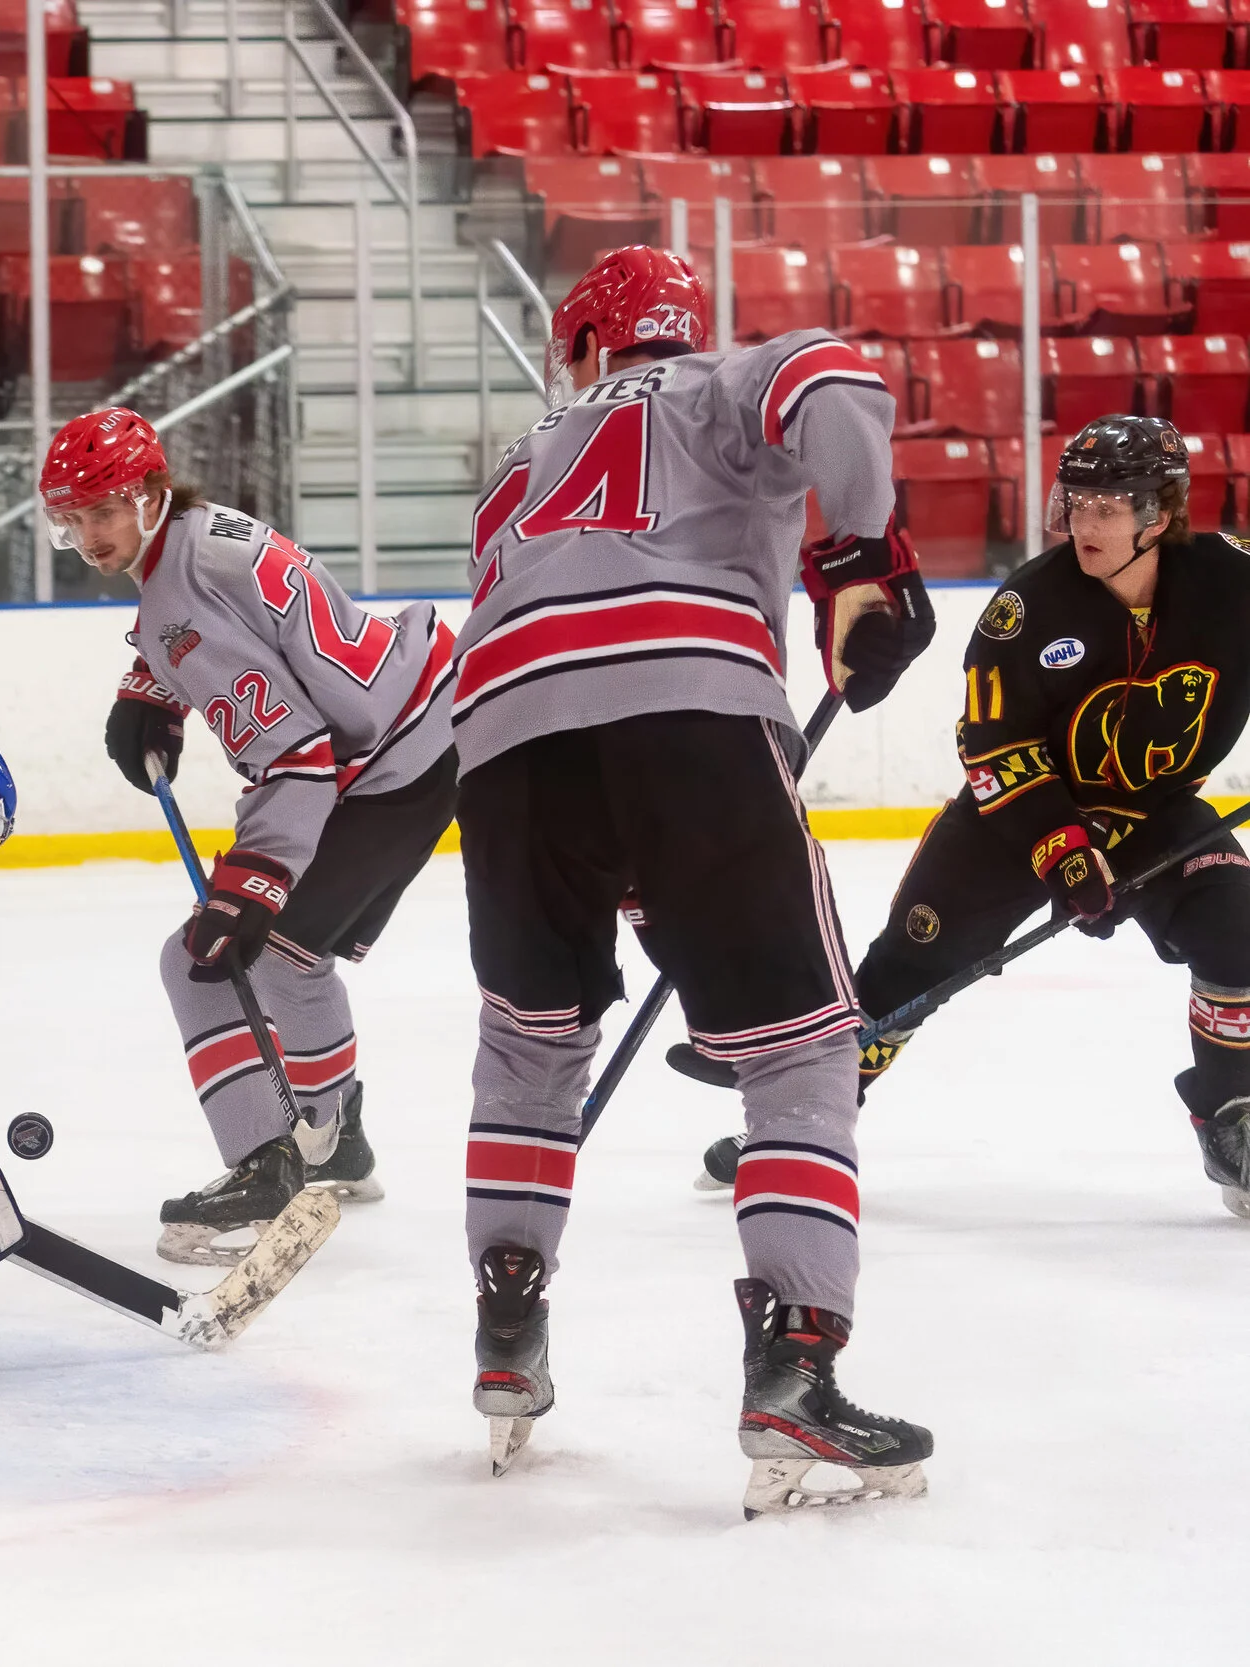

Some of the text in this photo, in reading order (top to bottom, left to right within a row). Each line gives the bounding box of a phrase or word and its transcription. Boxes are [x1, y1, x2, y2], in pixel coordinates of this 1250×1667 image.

[658, 304, 693, 341] 24
[1043, 643, 1082, 666] NAHL
[204, 669, 293, 759] 22
[966, 665, 1003, 724] 11
[268, 1066, 295, 1126] BAUER
